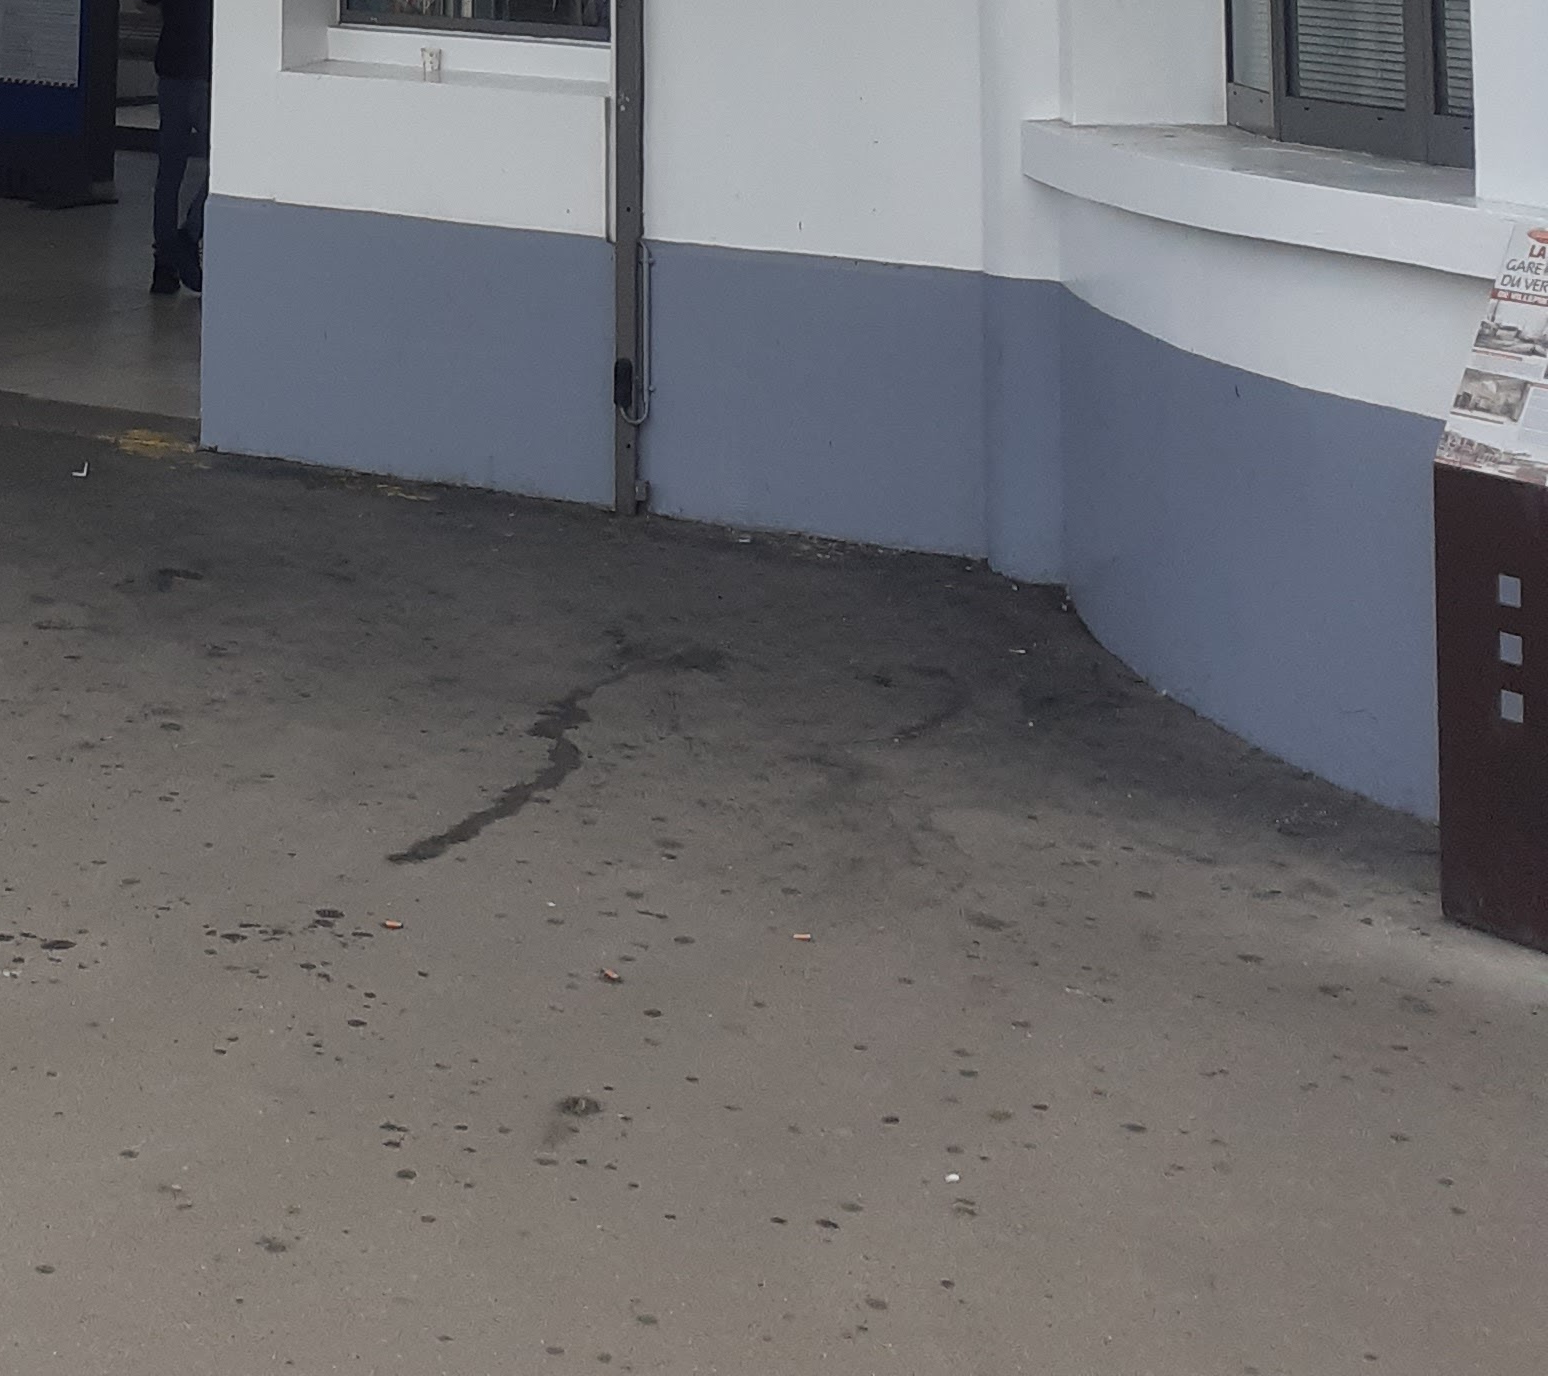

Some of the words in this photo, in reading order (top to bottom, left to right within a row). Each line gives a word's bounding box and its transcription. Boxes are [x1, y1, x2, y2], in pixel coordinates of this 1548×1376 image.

[1528, 244, 1546, 260] LA
[1505, 258, 1542, 276] GARE
[1500, 274, 1522, 288] DU
